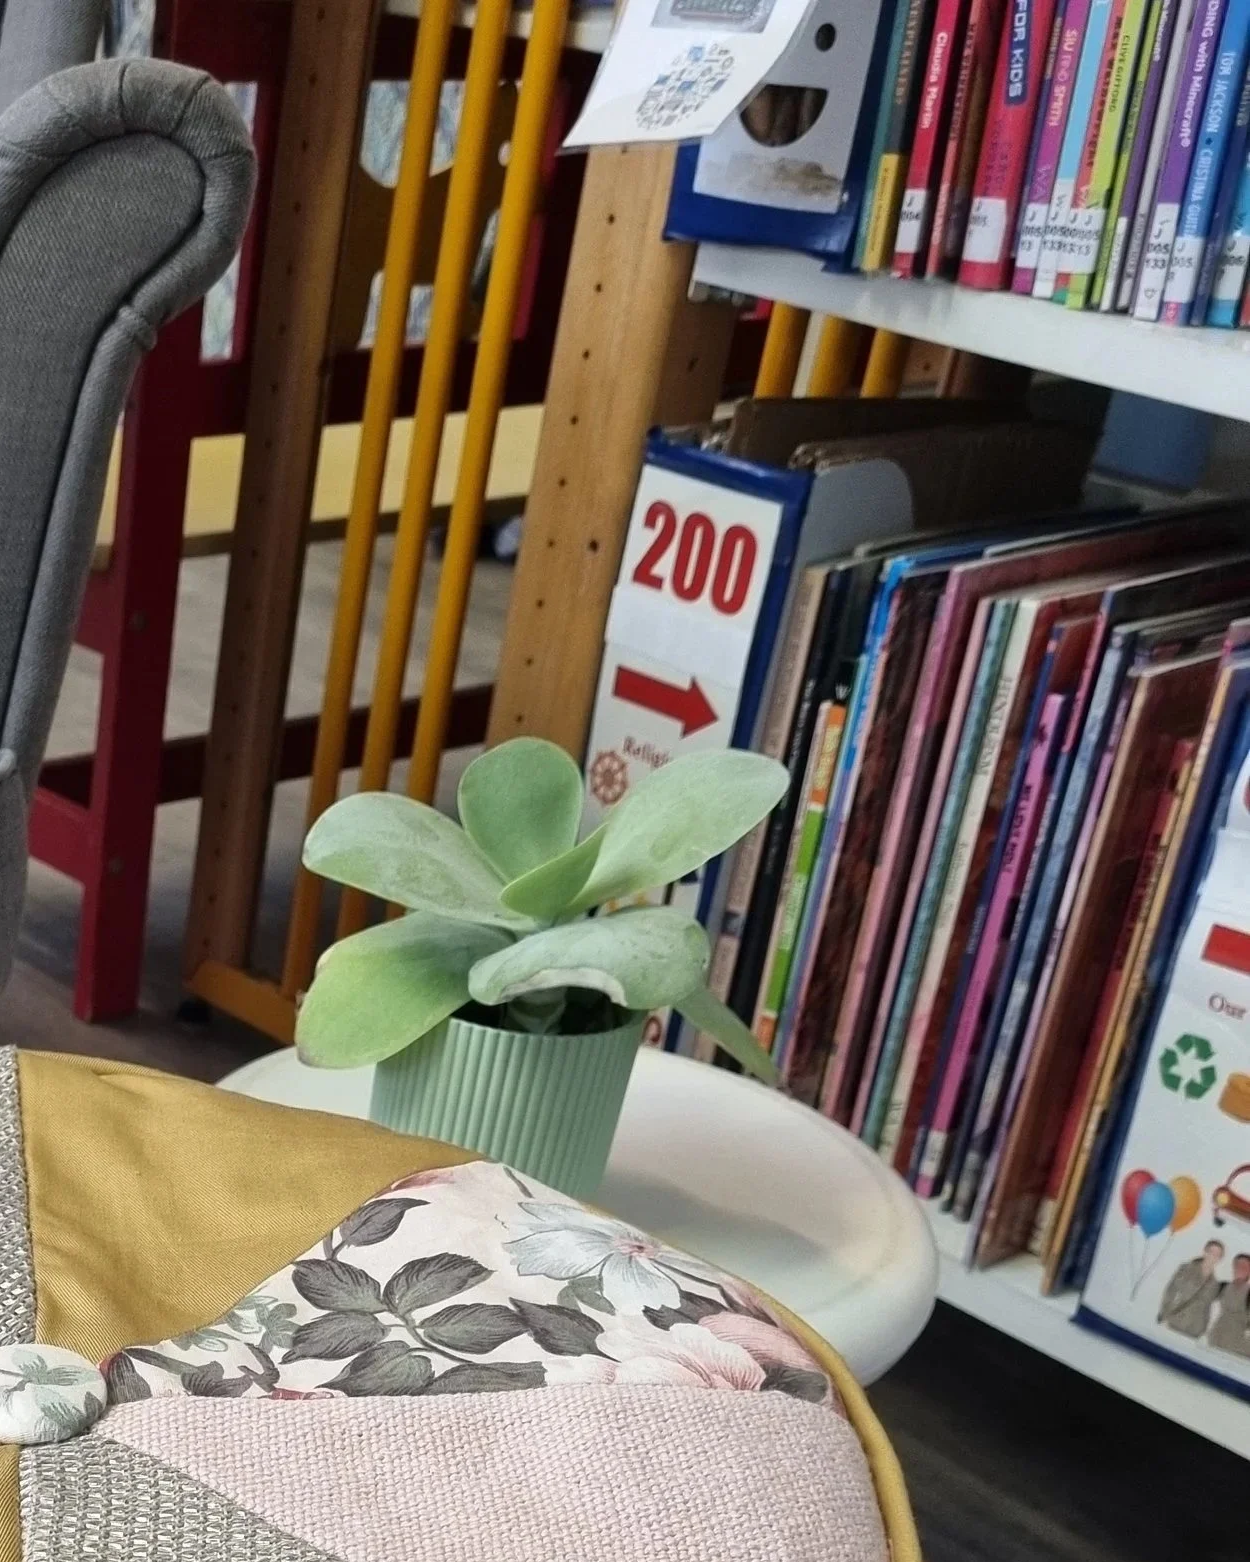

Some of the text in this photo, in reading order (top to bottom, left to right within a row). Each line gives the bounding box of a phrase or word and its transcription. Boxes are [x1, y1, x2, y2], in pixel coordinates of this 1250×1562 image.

[1009, 0, 1029, 98] FOR KIDS
[1109, 35, 1131, 113] CLIVE GIFFORD
[1193, 41, 1208, 73] with
[1219, 51, 1237, 76] TOM
[920, 32, 949, 130] Claudia Martin
[1206, 80, 1228, 133] JACKSON
[1191, 149, 1214, 202] CRISTINA
[1153, 227, 1162, 240] J
[632, 499, 758, 616] 200
[1208, 992, 1247, 1020] Our
